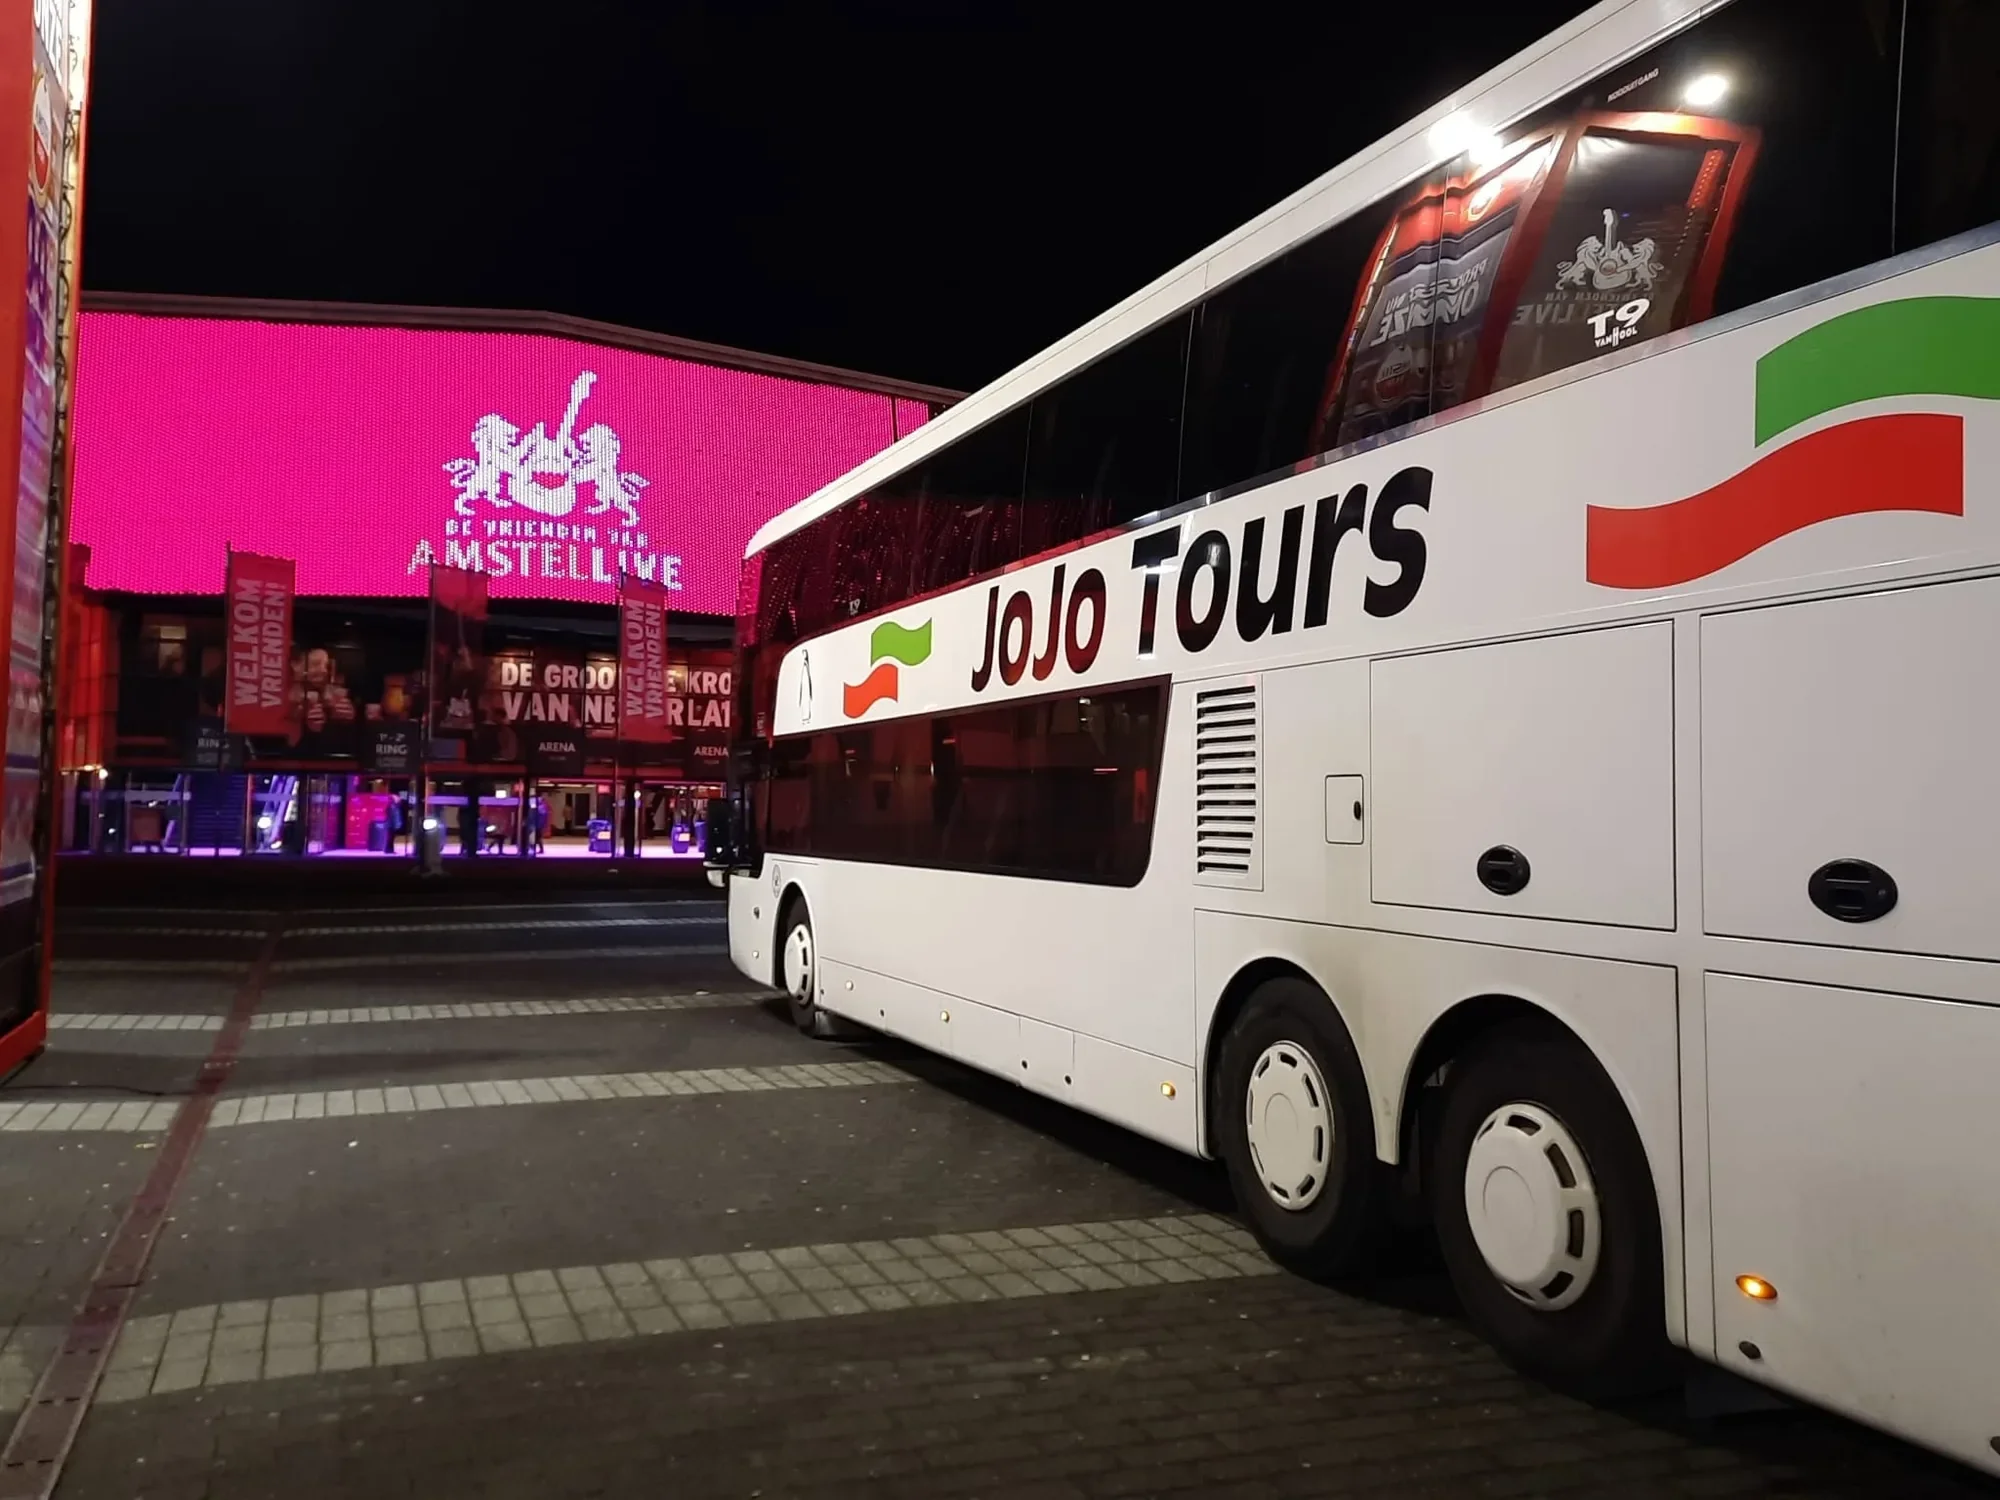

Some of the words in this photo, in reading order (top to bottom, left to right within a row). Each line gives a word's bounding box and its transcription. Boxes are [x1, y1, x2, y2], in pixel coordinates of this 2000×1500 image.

[1586, 298, 1650, 338] T9
[1131, 466, 1434, 657] Tours
[233, 577, 262, 708] WELKOM
[260, 582, 287, 709] VRIENDEN!
[501, 661, 533, 687] DE
[502, 691, 570, 722] VAN
[375, 743, 409, 756] RING
[538, 741, 576, 753] ARENA
[694, 745, 729, 758] ARENA
